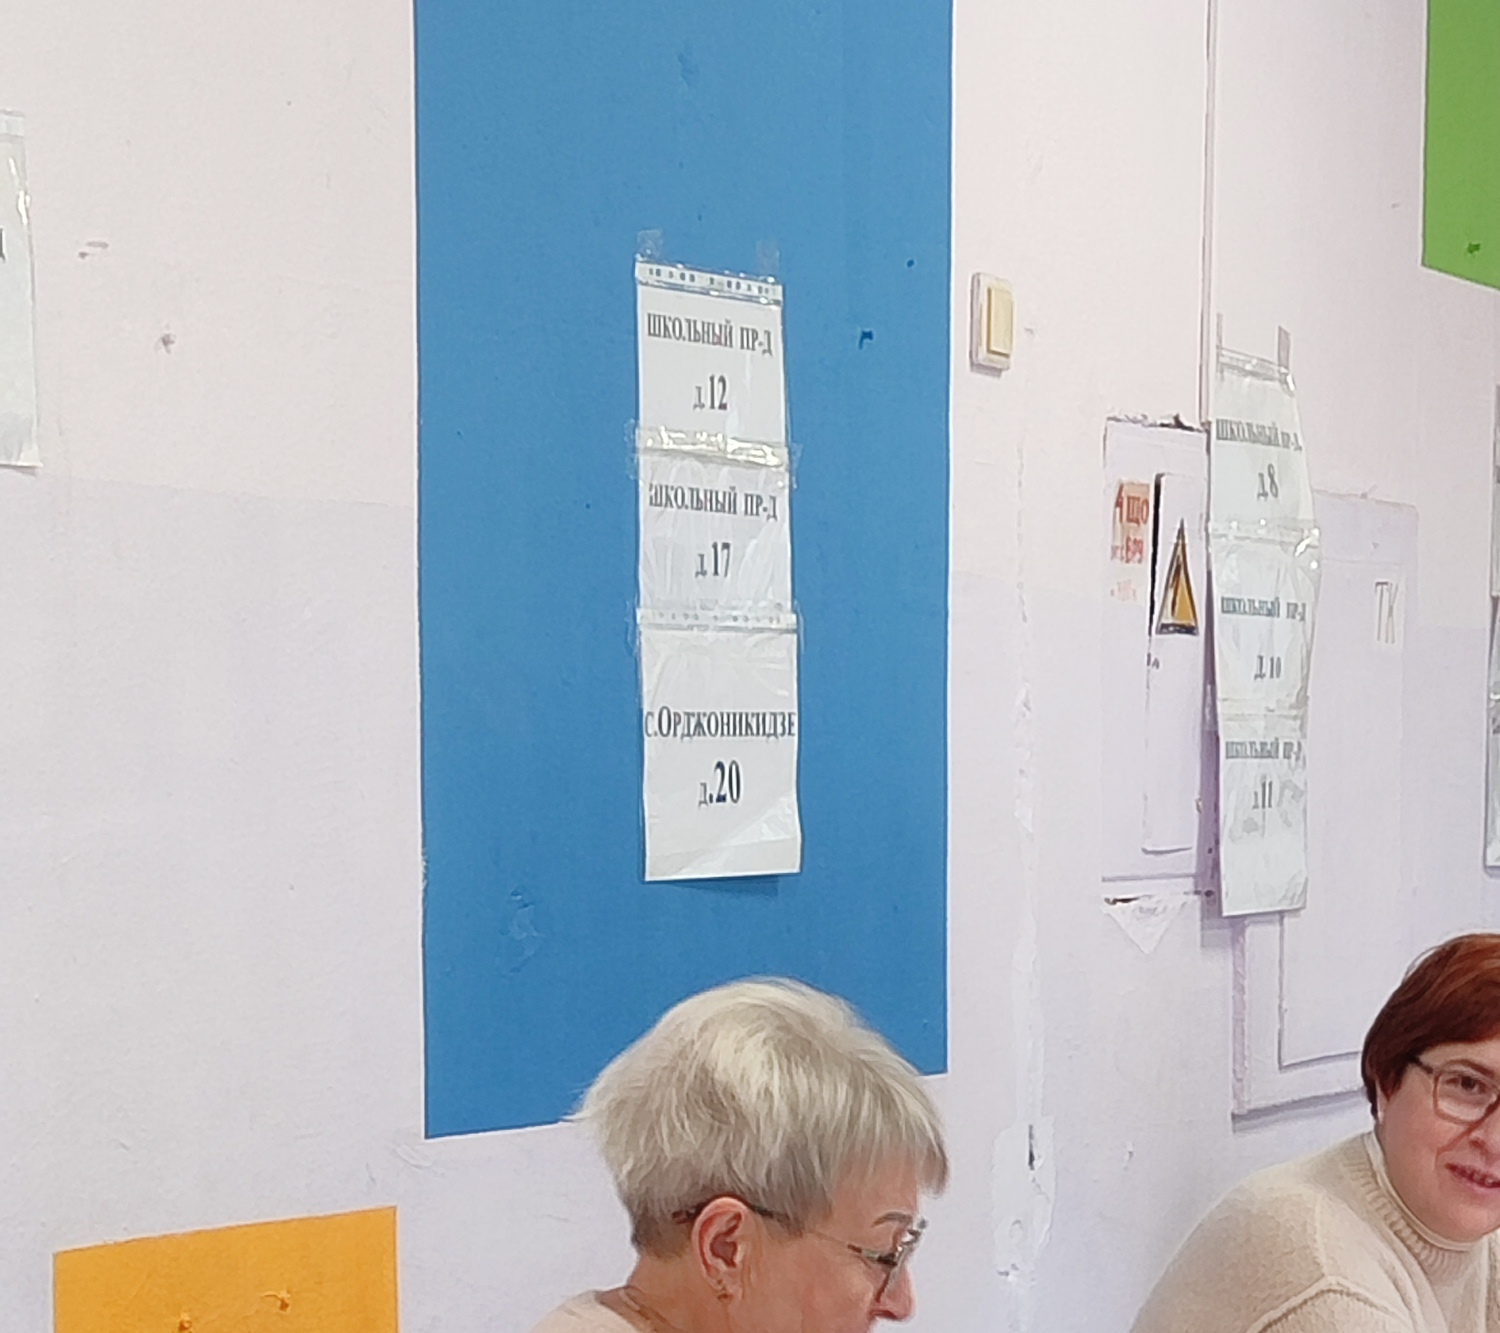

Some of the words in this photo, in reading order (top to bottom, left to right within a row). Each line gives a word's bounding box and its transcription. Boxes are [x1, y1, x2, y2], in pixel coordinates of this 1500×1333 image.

[647, 312, 733, 348] ШКОЛЬНЫЙ
[740, 326, 773, 356] ПР-Д
[649, 483, 737, 515] ШКОЛЬНЫЙ
[744, 493, 777, 521] ПР-Д
[698, 759, 741, 807] д.20
